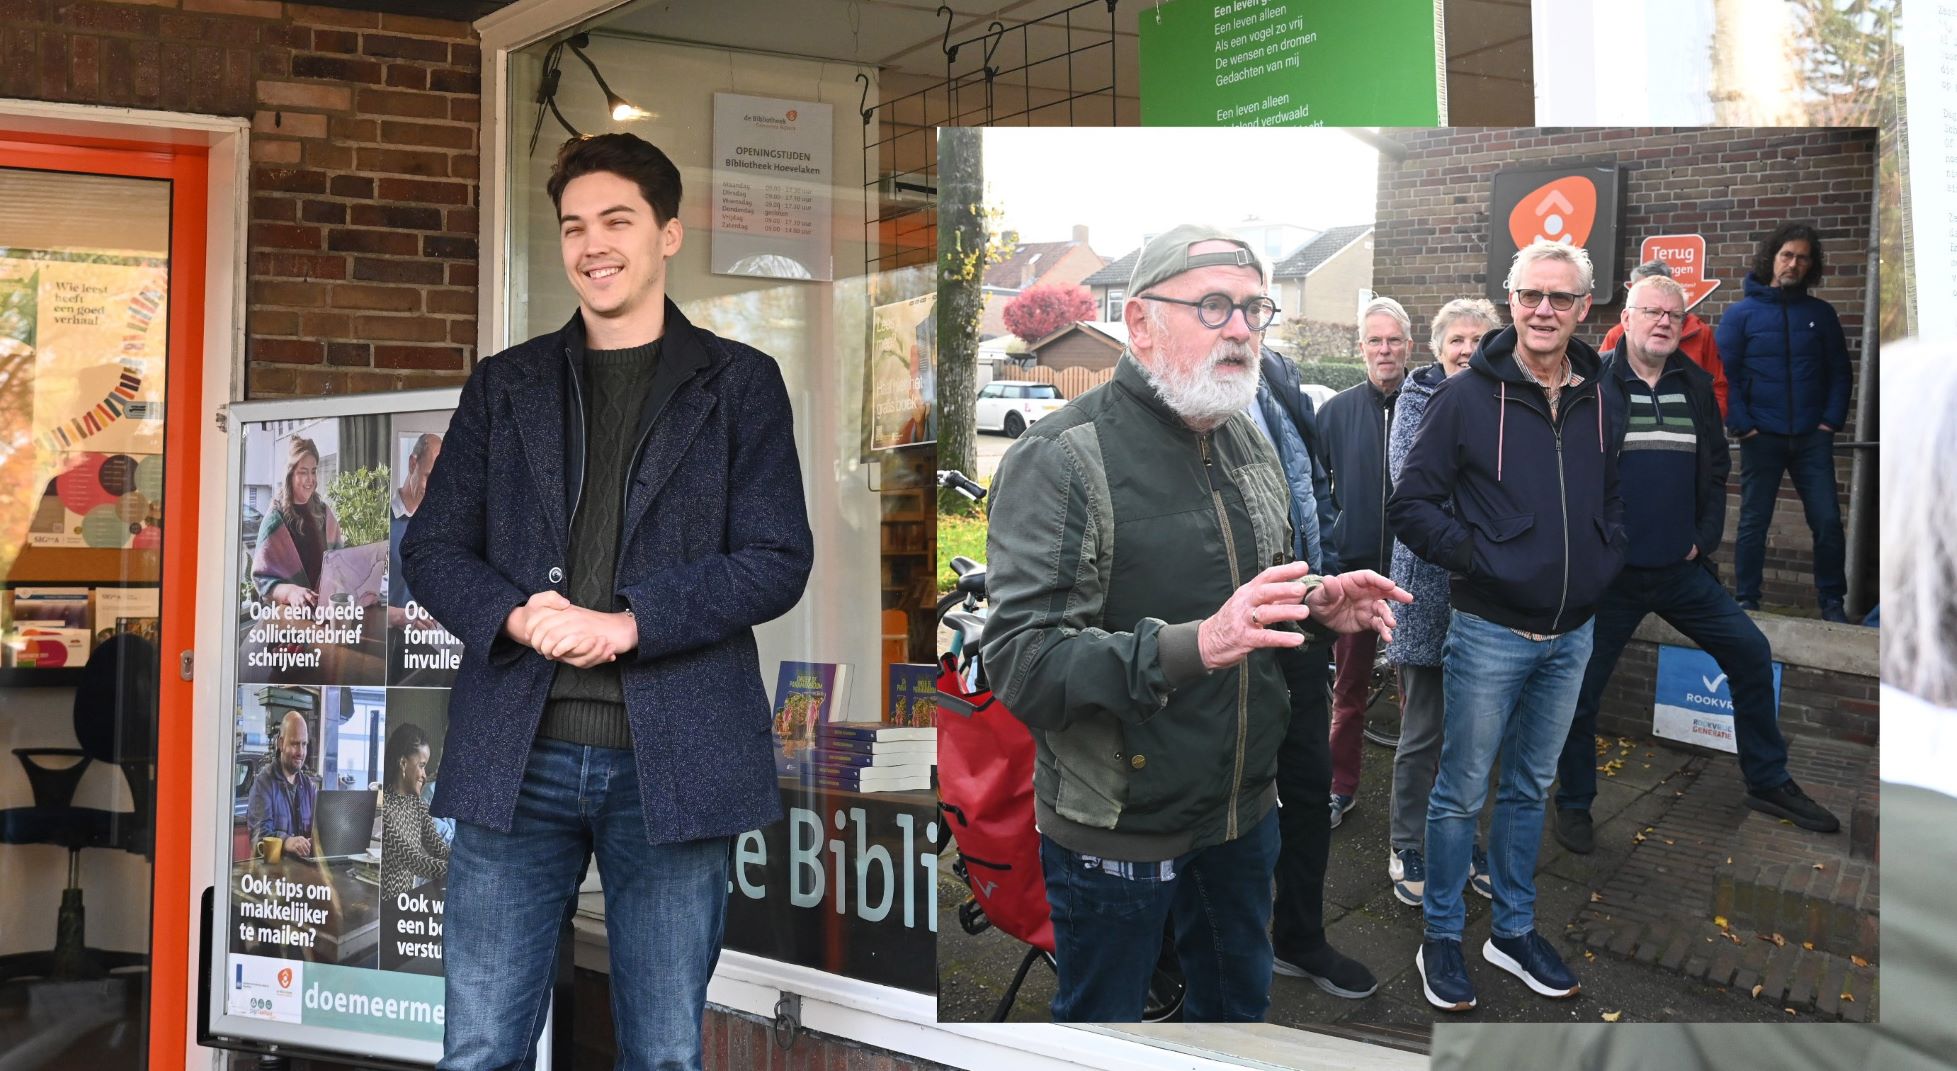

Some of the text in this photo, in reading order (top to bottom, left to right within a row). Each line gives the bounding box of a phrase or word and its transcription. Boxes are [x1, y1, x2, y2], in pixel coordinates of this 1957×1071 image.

[1214, 5, 1232, 18] Een
[1214, 5, 1287, 36] Een leven alleen
[1214, 15, 1303, 53] Als een vogel zo vrij
[1215, 32, 1317, 70] De wensen en dromen
[1215, 51, 1300, 87] Gedachten van mij
[1216, 94, 1290, 121] Een leven alleen
[1261, 103, 1309, 127] verdwaald
[735, 146, 811, 162] OPENINGSTIJDEN
[725, 158, 820, 175] Bibliotheek Hoevelaken
[1651, 246, 1694, 263] Terug
[55, 292, 83, 303] heeft
[56, 281, 108, 293] Wie leest
[77, 305, 105, 316] goed
[249, 599, 364, 625] Ook een goede
[404, 600, 434, 621] Oo
[249, 624, 363, 645] sollicitatiebrief
[404, 624, 465, 645] formu
[248, 648, 321, 672] schrijven?
[404, 648, 464, 670] invulle
[1691, 726, 1733, 740] GENERATIE
[728, 828, 767, 899] e
[240, 873, 331, 902] Ook tips om
[240, 900, 329, 927] makkelijker
[397, 892, 429, 913] Ook
[239, 923, 316, 948] te mailen?
[396, 918, 425, 935] een
[304, 981, 446, 1024] doemeerme
